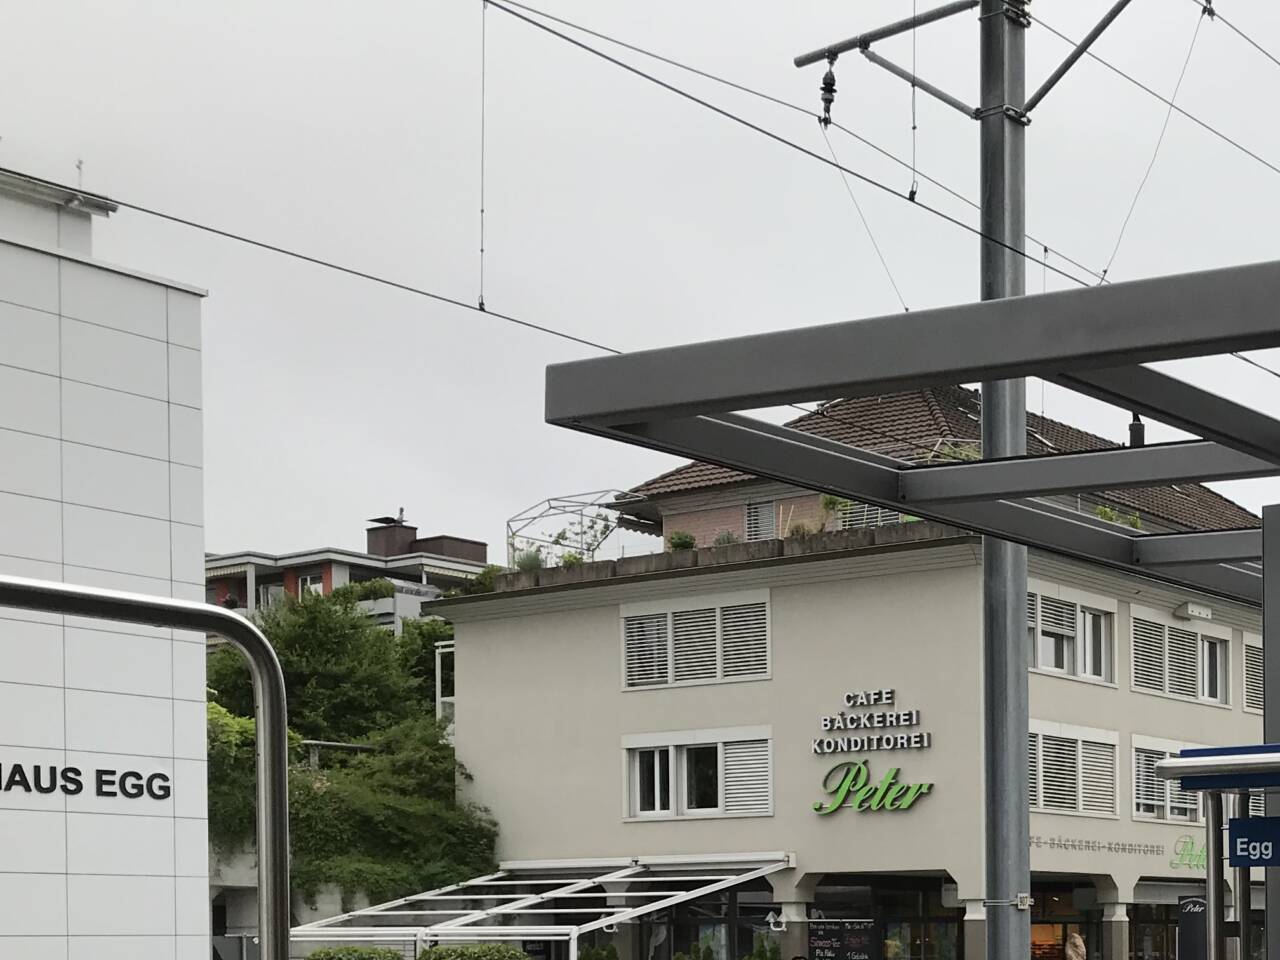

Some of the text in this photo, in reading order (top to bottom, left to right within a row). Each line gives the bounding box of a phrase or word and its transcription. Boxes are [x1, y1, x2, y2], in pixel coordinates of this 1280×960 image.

[843, 689, 896, 707] CAFE
[821, 710, 920, 731] BÄCKEREI
[811, 732, 931, 754] KONDITOREI
[0, 763, 171, 800] AUS EGG
[811, 760, 934, 816] Peter
[1236, 838, 1273, 860] Egg
[1182, 903, 1205, 913] Peter
